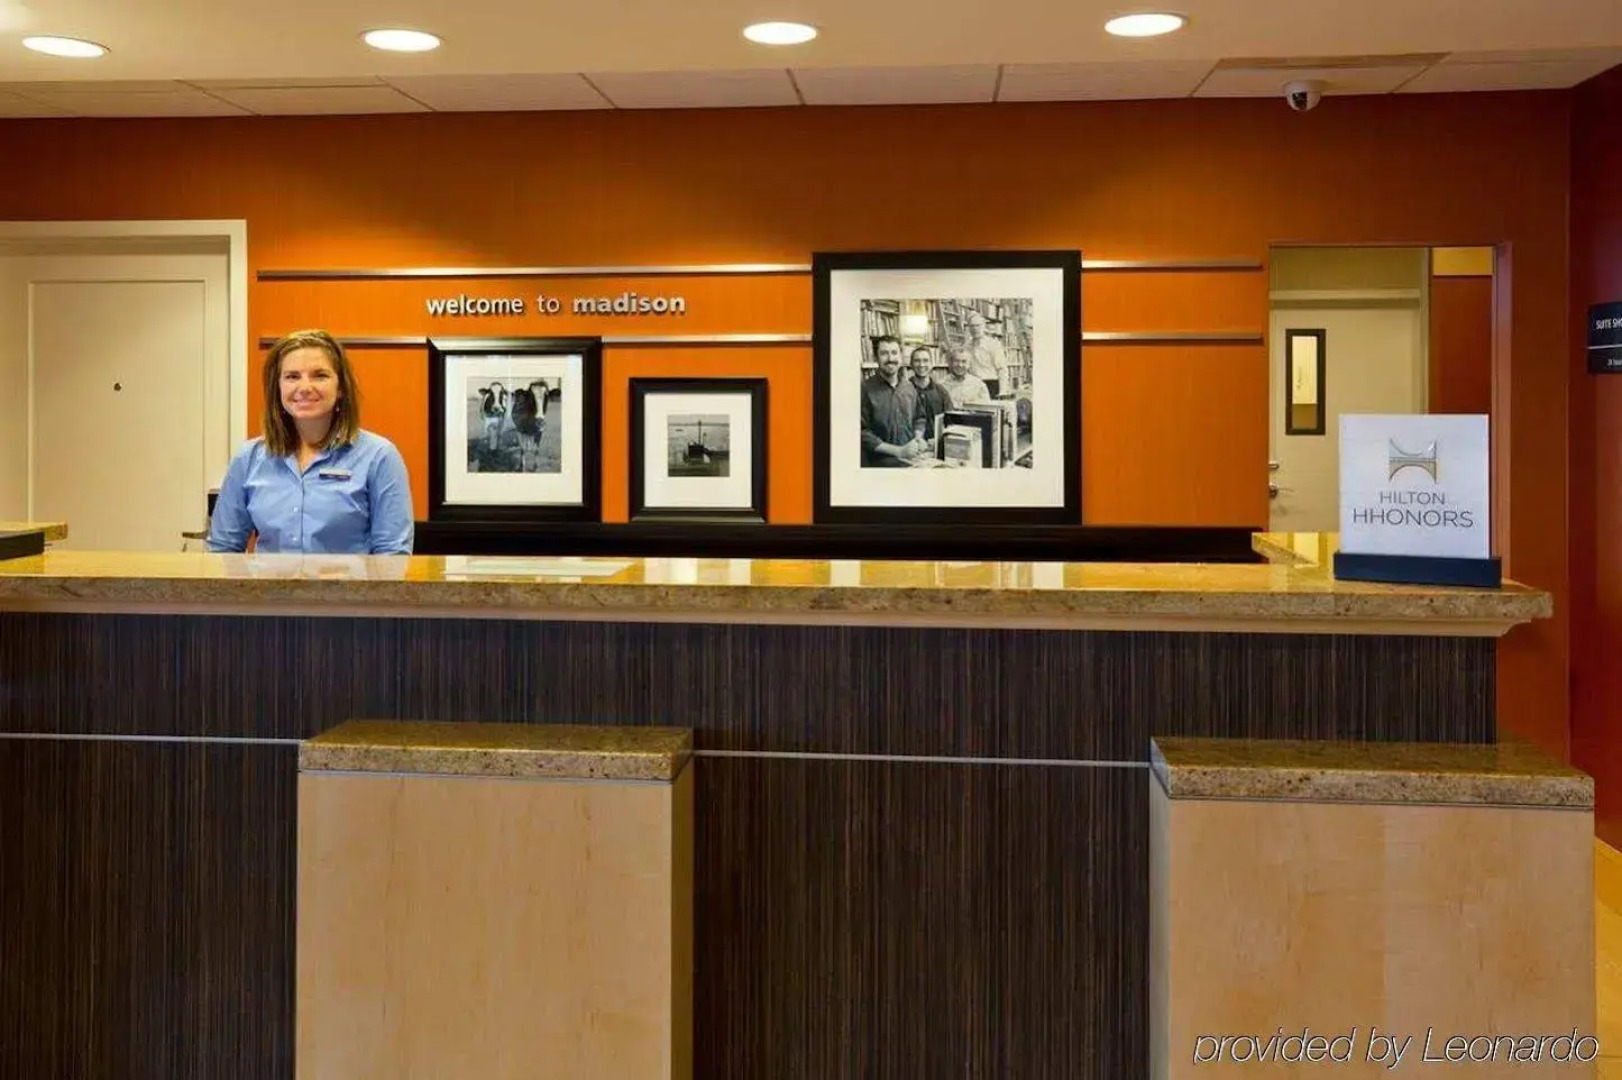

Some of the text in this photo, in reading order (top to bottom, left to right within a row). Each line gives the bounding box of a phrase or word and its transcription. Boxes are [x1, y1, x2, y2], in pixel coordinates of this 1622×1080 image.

[426, 292, 686, 316] welcome to madison
[1379, 491, 1446, 505] HILTON
[1353, 507, 1474, 528] HHONORS
